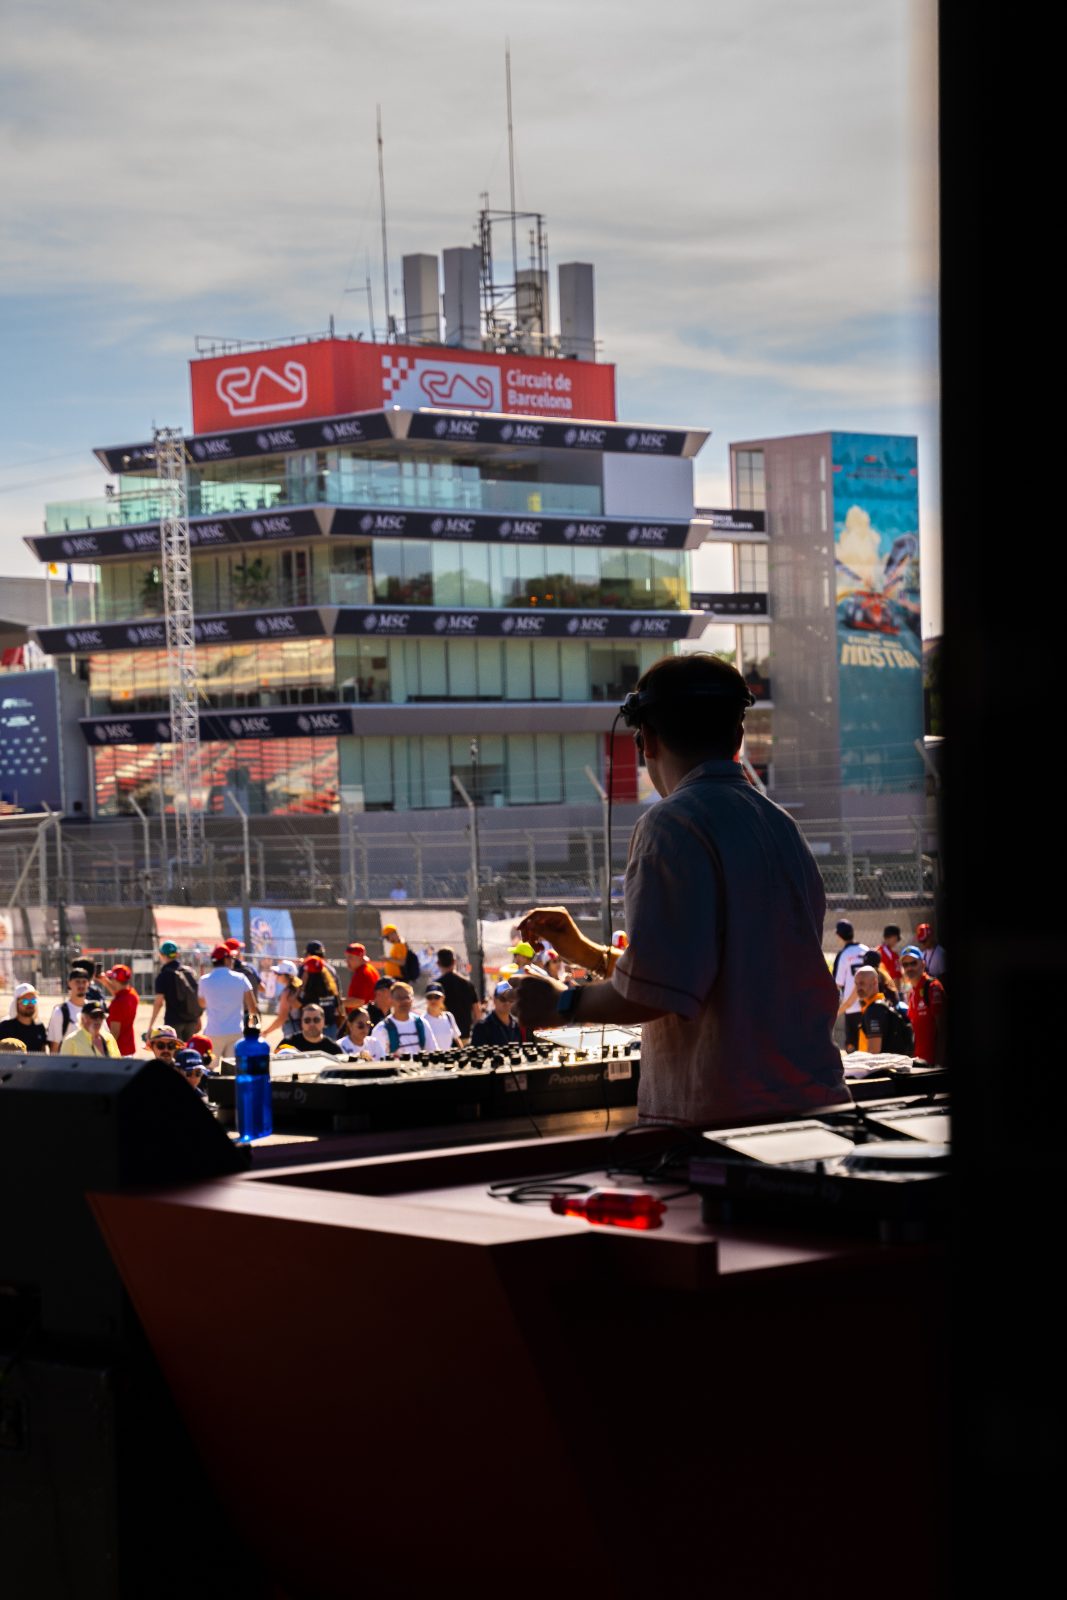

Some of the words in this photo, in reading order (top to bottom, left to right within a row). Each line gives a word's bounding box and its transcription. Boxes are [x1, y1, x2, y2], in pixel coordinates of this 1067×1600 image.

[506, 369, 553, 390] Circuit
[554, 373, 572, 391] de
[507, 388, 573, 409] Barcelona
[333, 421, 364, 438] MSC
[449, 419, 479, 436] MSC
[512, 424, 544, 440] MSC
[268, 430, 297, 446] MSC
[577, 428, 607, 444] MSC
[638, 432, 668, 448] MSC
[204, 438, 232, 453] MSC
[262, 516, 292, 533] MSC
[374, 513, 407, 530] MSC
[444, 517, 476, 533] MSC
[512, 521, 543, 536] MSC
[133, 529, 160, 546] MSC
[197, 524, 225, 540] MSC
[577, 523, 607, 538] MSC
[640, 526, 669, 541] MSC
[71, 536, 99, 551] MSC
[199, 619, 230, 636] MSC
[266, 614, 297, 632] MSC
[378, 613, 410, 629] MSC
[447, 614, 480, 630] MSC
[514, 615, 546, 631] MSC
[579, 616, 610, 631] MSC
[642, 617, 671, 632] MSC
[73, 630, 103, 646] MSC
[138, 624, 164, 640] MSC
[240, 715, 272, 733] MSC
[307, 713, 343, 730] MSC
[105, 722, 134, 739] MSC
[549, 1071, 600, 1085] Pioneer
